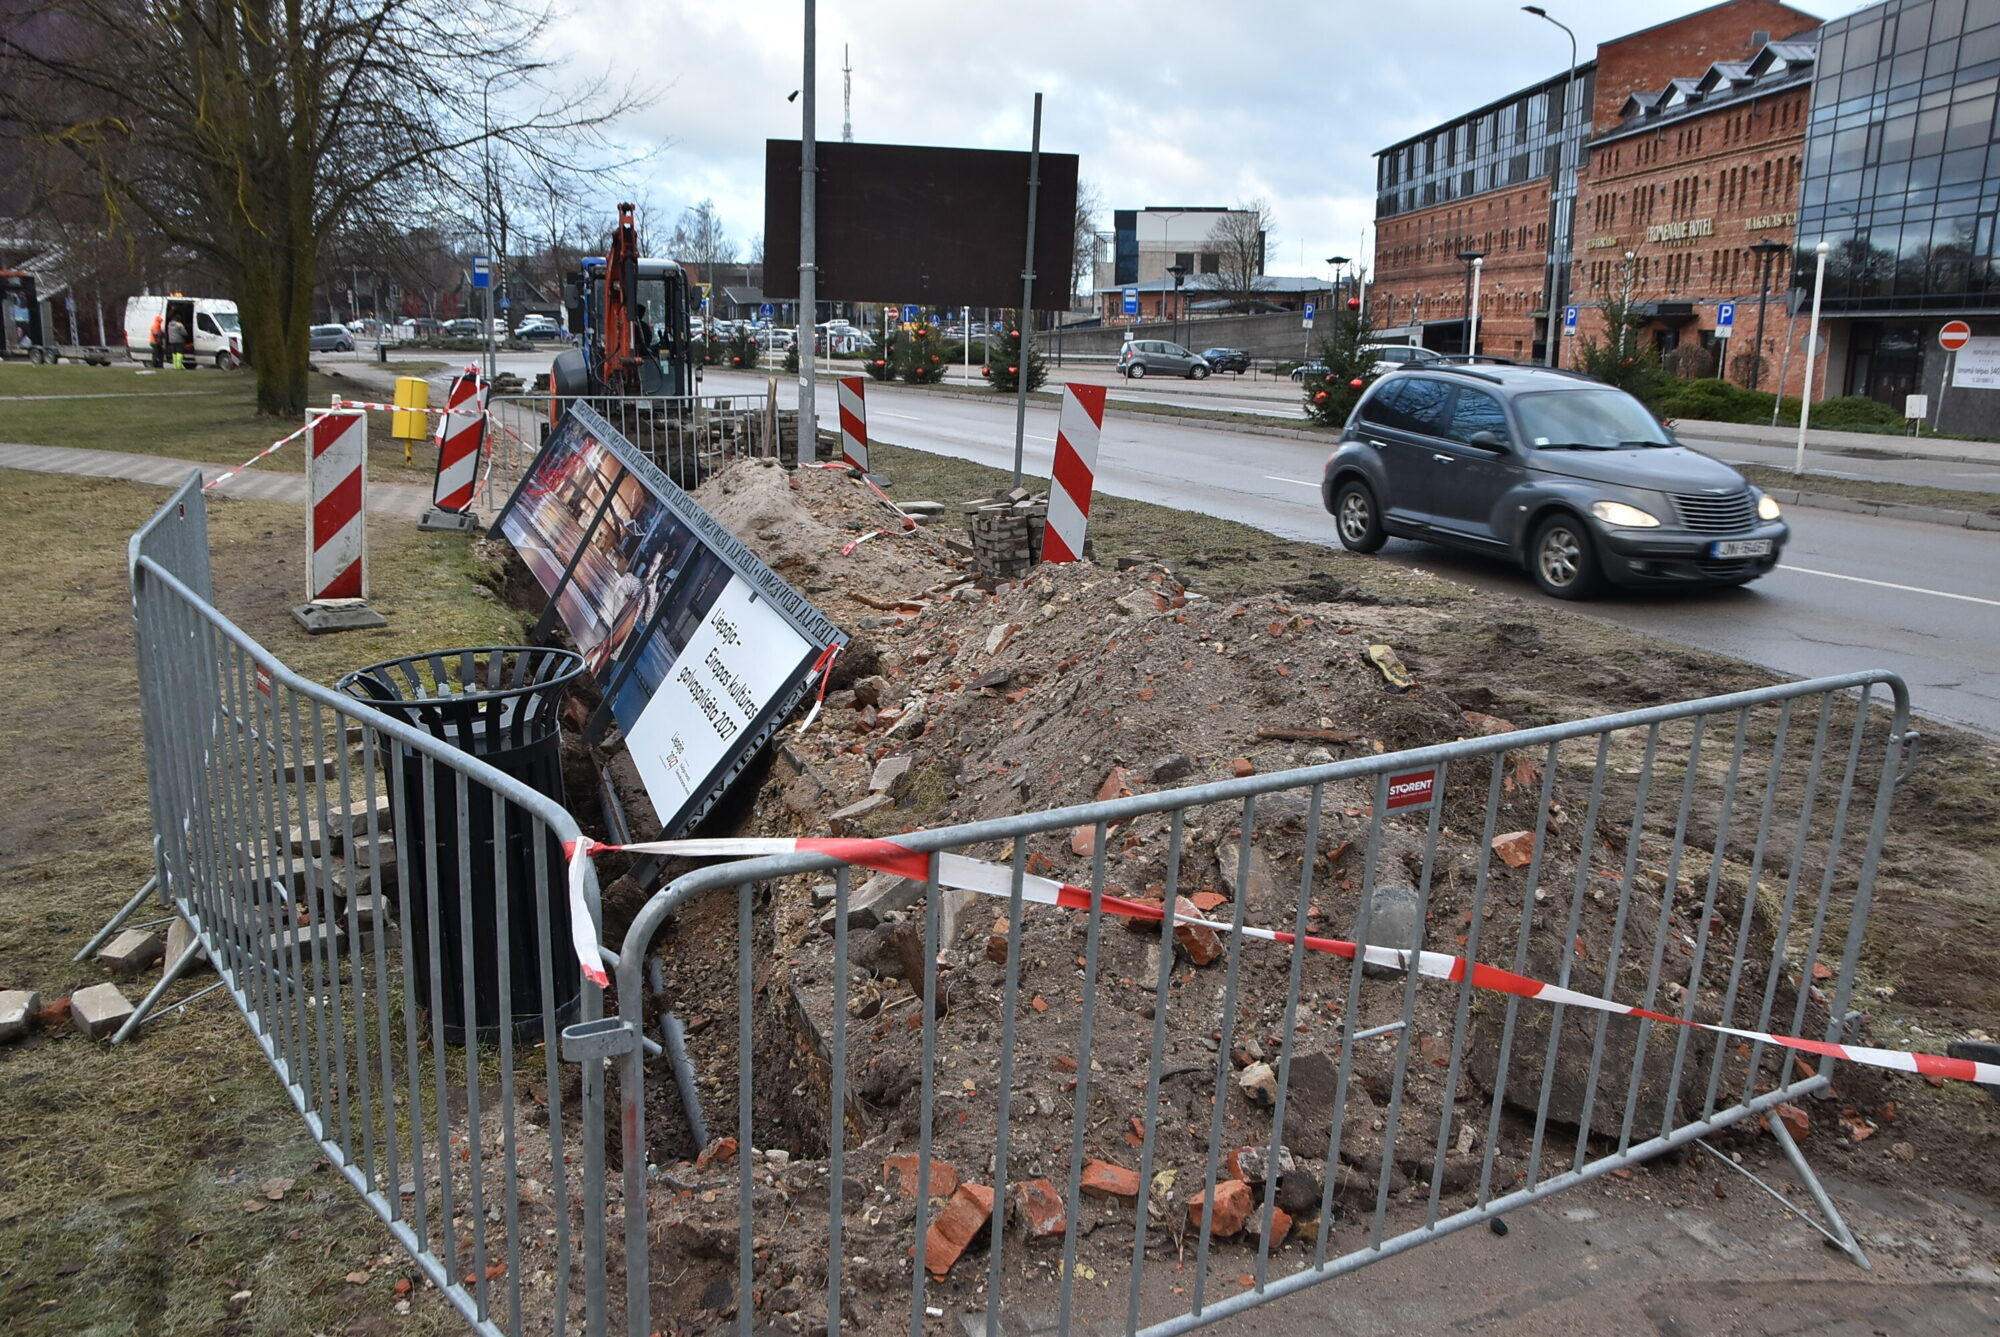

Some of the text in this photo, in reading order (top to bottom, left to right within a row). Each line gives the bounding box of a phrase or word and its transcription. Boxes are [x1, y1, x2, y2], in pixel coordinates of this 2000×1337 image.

[1689, 218, 1713, 237] HOTEL
[711, 607, 738, 645] Liepāja
[704, 647, 758, 721] Eiropas kultūras
[677, 666, 738, 742] galvaspilsēta 2027
[1389, 780, 1432, 796] STORENT
